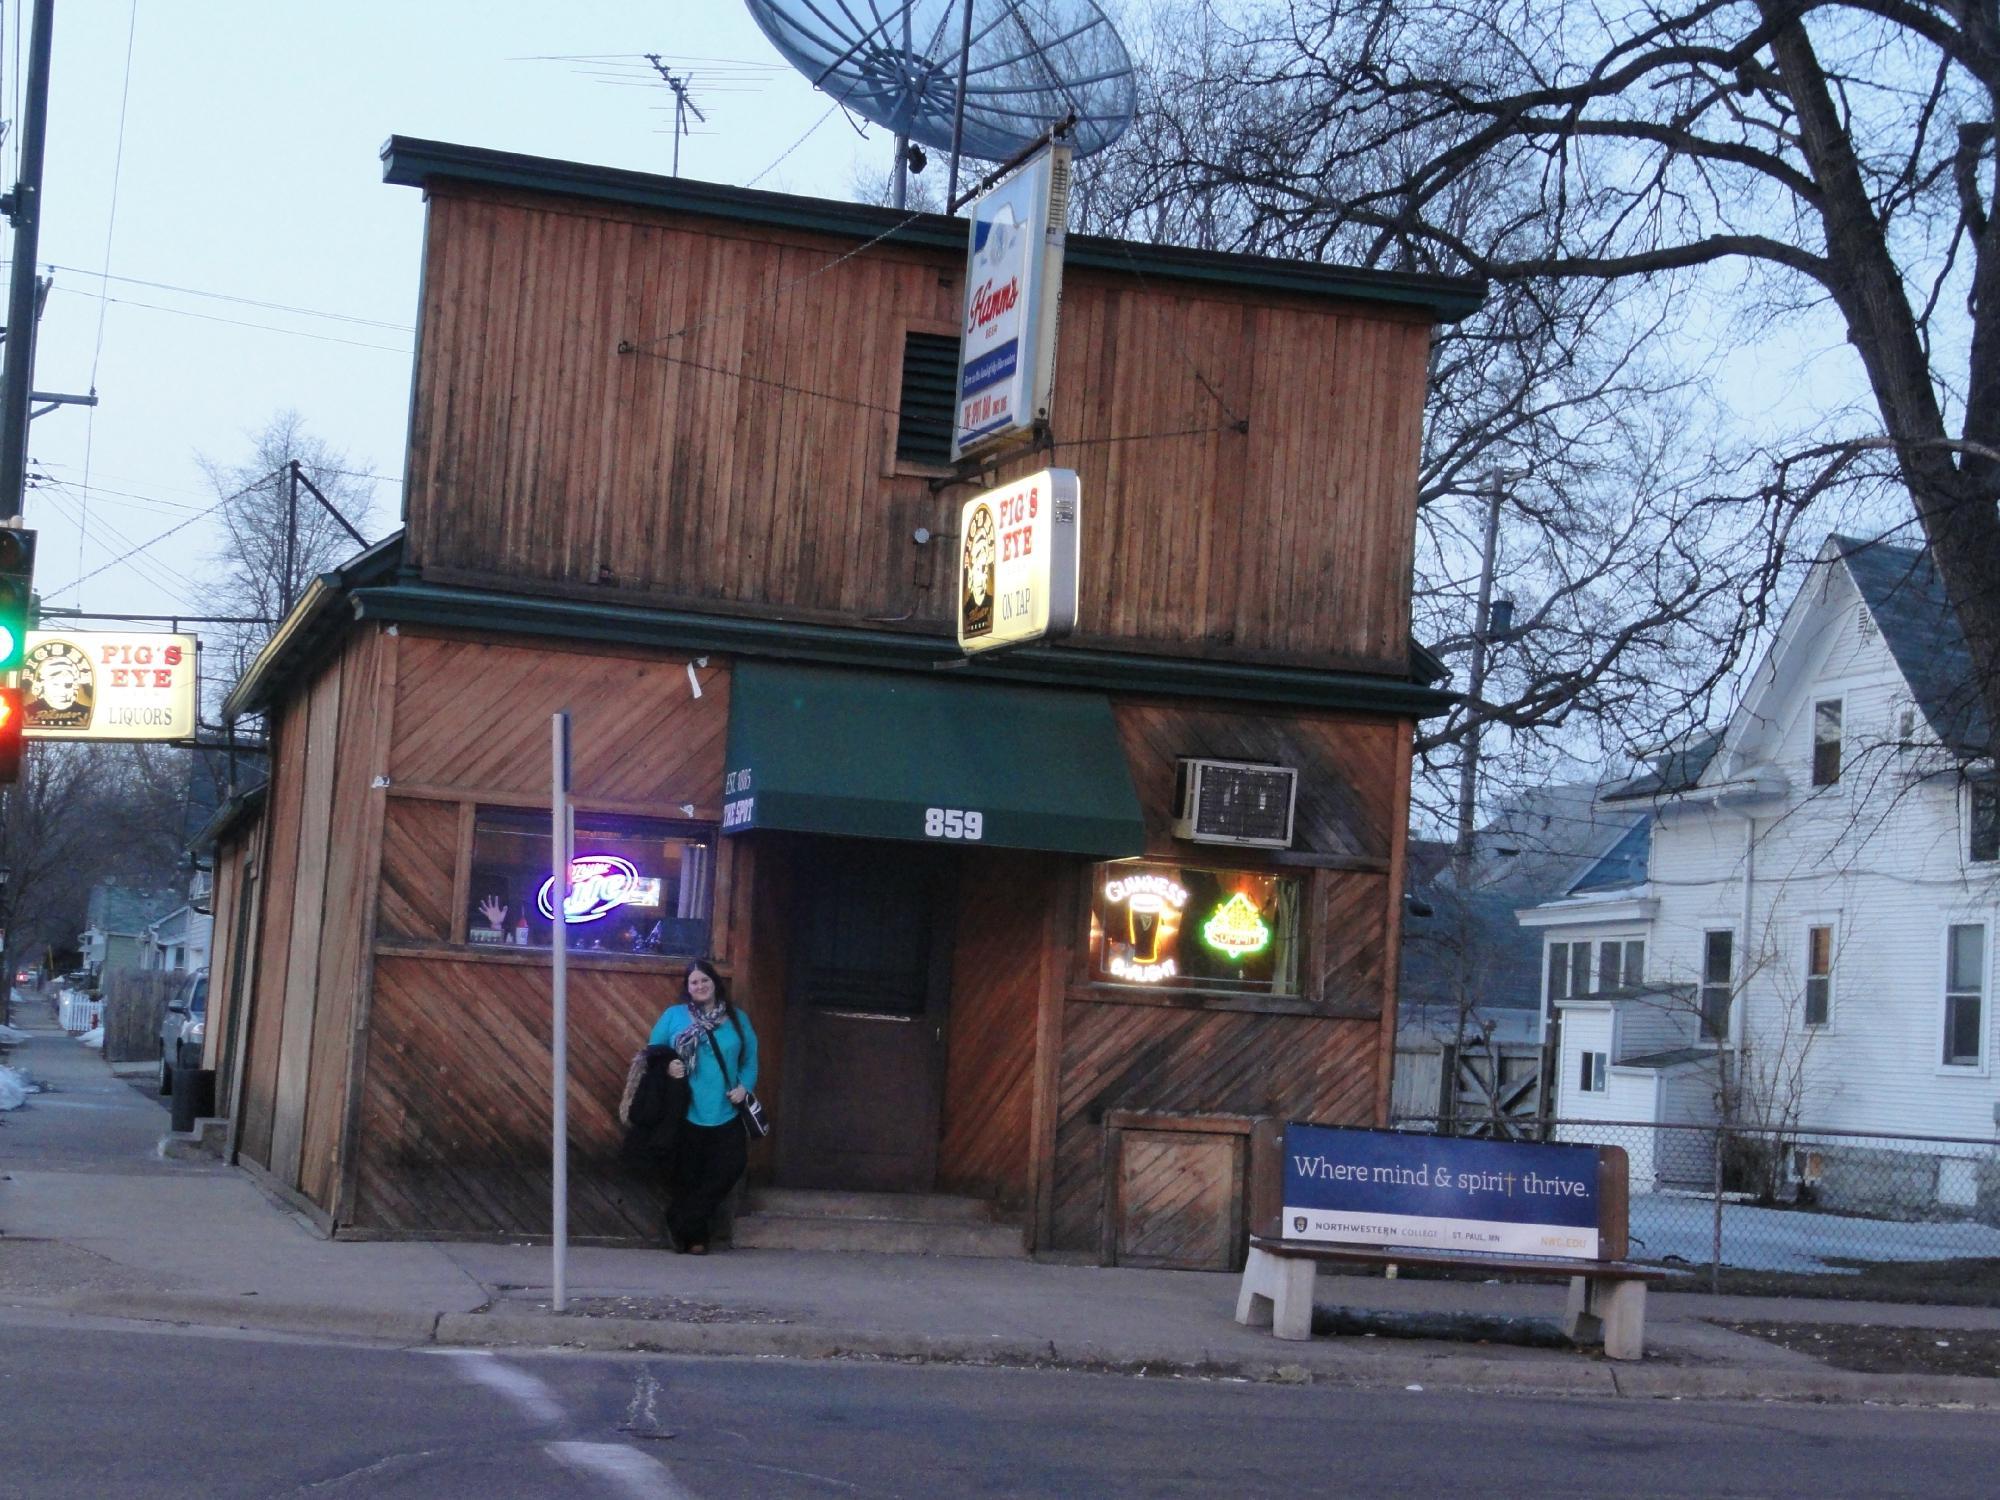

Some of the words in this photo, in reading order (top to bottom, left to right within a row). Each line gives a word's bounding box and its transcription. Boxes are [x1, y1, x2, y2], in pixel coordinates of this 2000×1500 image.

[968, 275, 1018, 334] Hamm's
[999, 487, 1038, 529] PIG'S
[1002, 526, 1033, 562] EYE
[1002, 594, 1013, 620] ON
[1015, 587, 1030, 617] TAP
[101, 644, 182, 665] PIG'S
[110, 668, 172, 688] EYE
[109, 707, 172, 726] LIQUORS
[925, 808, 983, 840] 859
[1105, 875, 1187, 907] GUINNESS
[1212, 931, 1261, 945] SUMMIT
[1293, 1156, 1368, 1182] Where
[1373, 1163, 1429, 1187] mind
[1434, 1167, 1451, 1188] &
[1523, 1172, 1590, 1198] thrive.
[1315, 1222, 1397, 1236] NORTHWESTERN
[1402, 1228, 1438, 1239] COLLEGE
[1488, 1235, 1501, 1243] MN
